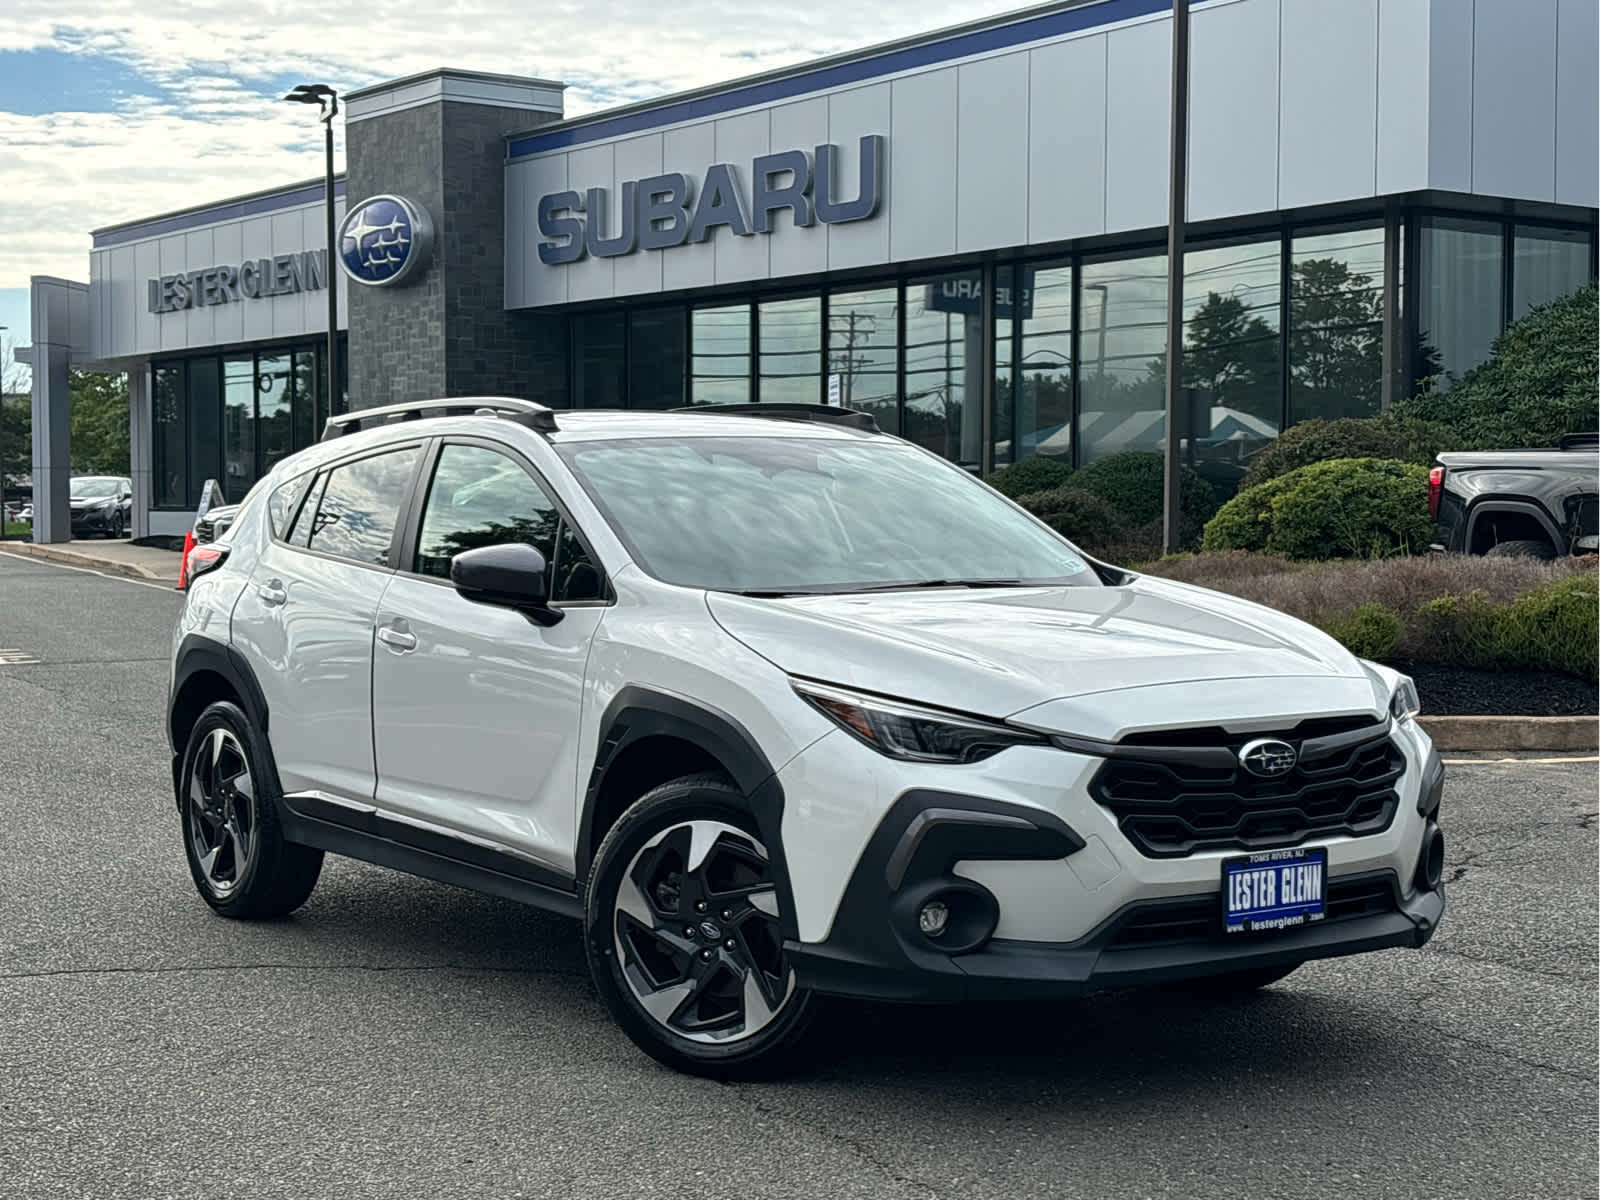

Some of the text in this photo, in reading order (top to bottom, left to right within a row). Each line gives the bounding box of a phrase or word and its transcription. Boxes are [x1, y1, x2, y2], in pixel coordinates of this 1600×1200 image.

[537, 135, 882, 265] SUBARU
[148, 249, 328, 314] LESTER GLENN
[1250, 853, 1270, 863] TOMS
[1295, 849, 1304, 857] NJ
[1228, 864, 1322, 911] LESTER GLENN
[1251, 915, 1304, 931] lesterglenn
